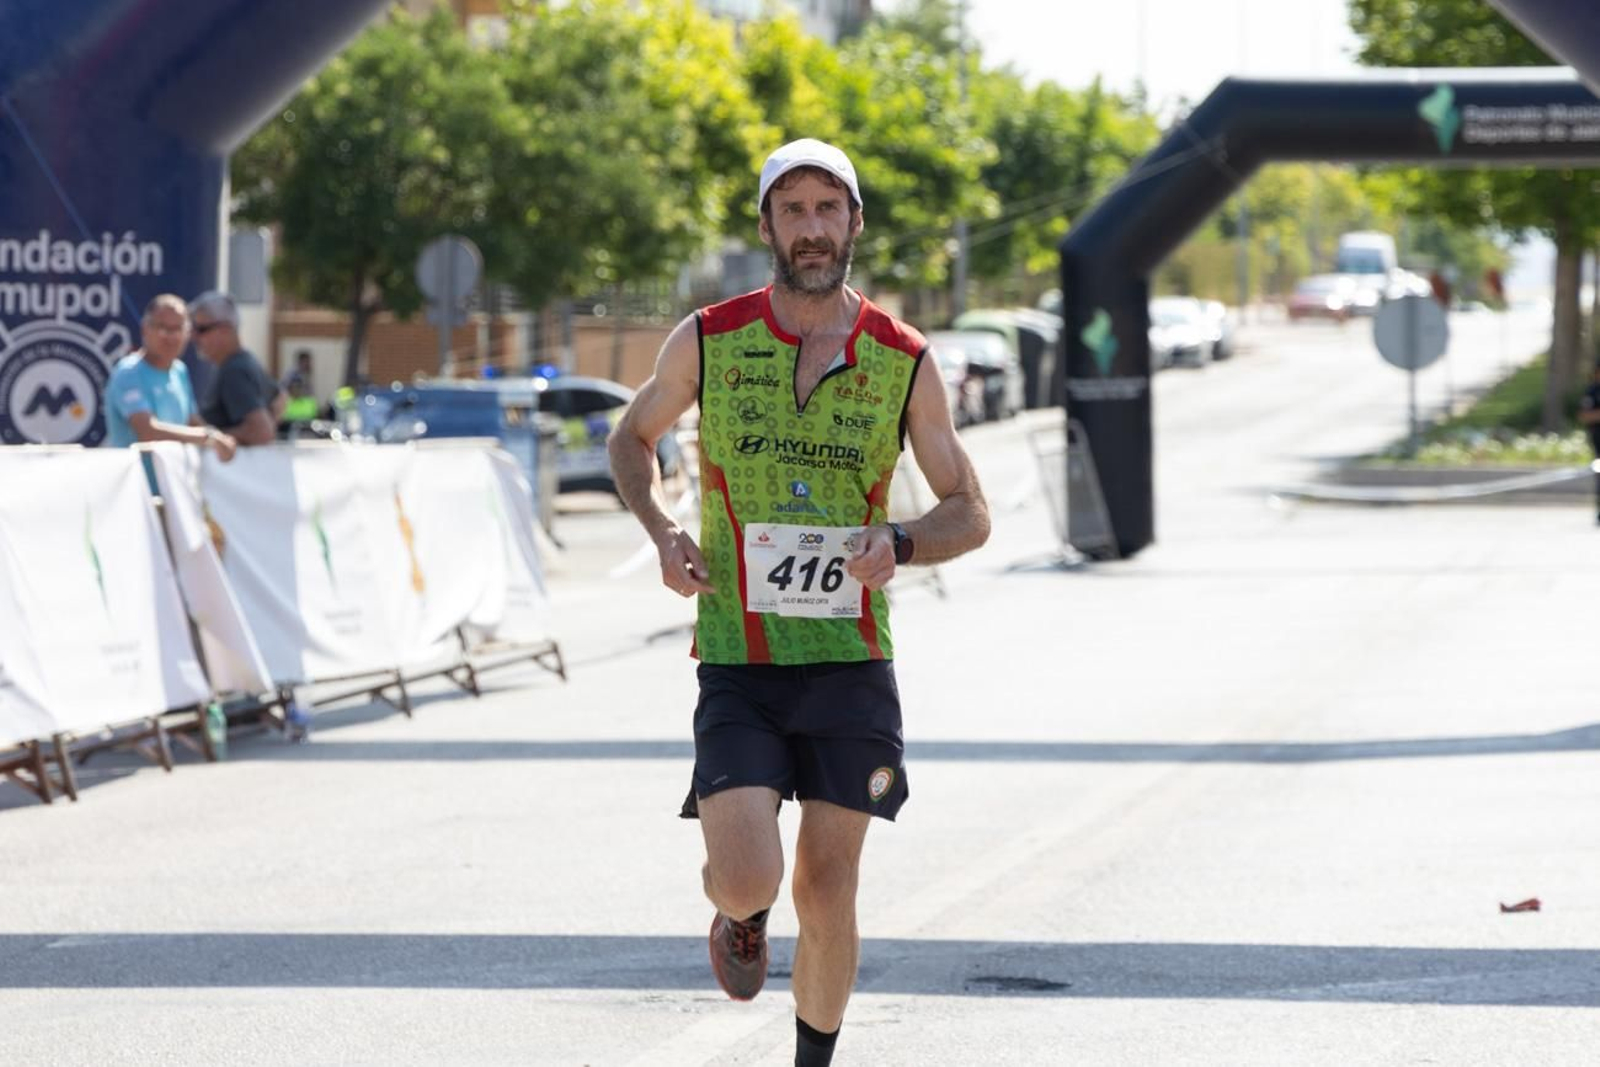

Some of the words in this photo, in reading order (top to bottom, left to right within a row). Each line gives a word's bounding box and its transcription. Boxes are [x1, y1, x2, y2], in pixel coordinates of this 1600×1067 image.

[0, 229, 163, 276] ndación
[845, 416, 875, 431] DUE
[775, 438, 865, 464] HYUNDAI
[767, 555, 846, 594] 416
